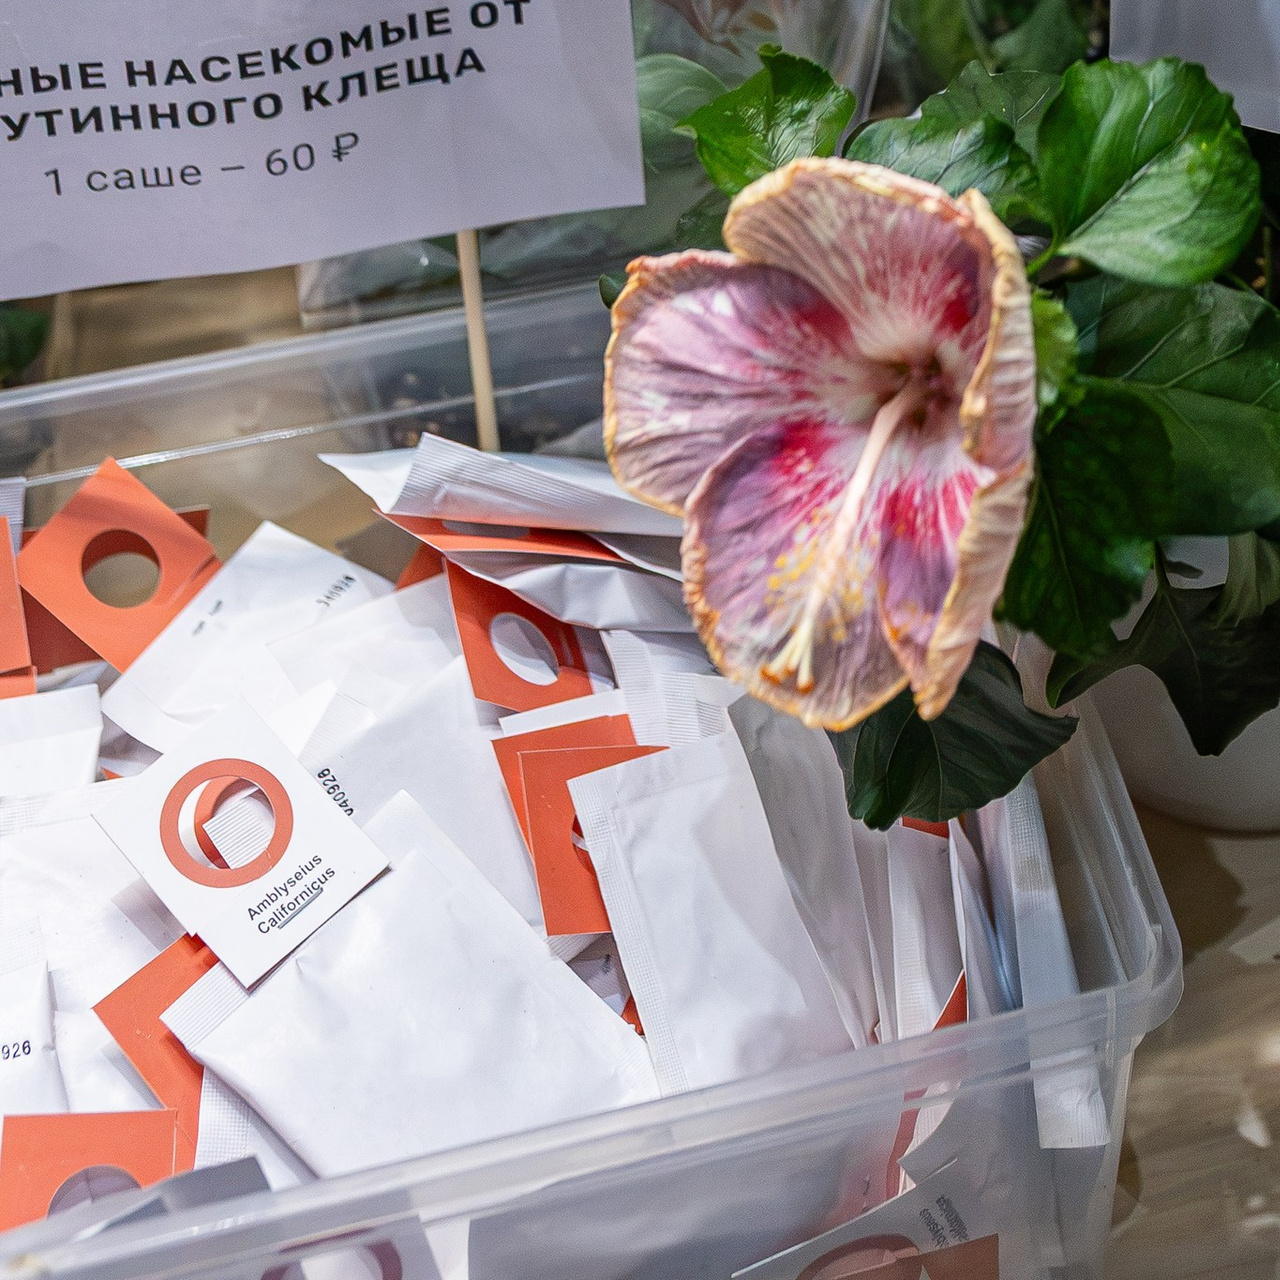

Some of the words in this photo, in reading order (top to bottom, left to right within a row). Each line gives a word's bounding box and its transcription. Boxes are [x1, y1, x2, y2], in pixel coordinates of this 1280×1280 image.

[124, 6, 453, 88] НАСЕКОМЫЕ
[0, 92, 284, 141] УТИННОГО
[301, 47, 486, 112] КЛЕЩА
[44, 168, 63, 197] 1
[85, 164, 203, 192] саше
[265, 143, 316, 176] 60
[247, 854, 322, 921] Amblyseius
[257, 867, 336, 934] Californicus
